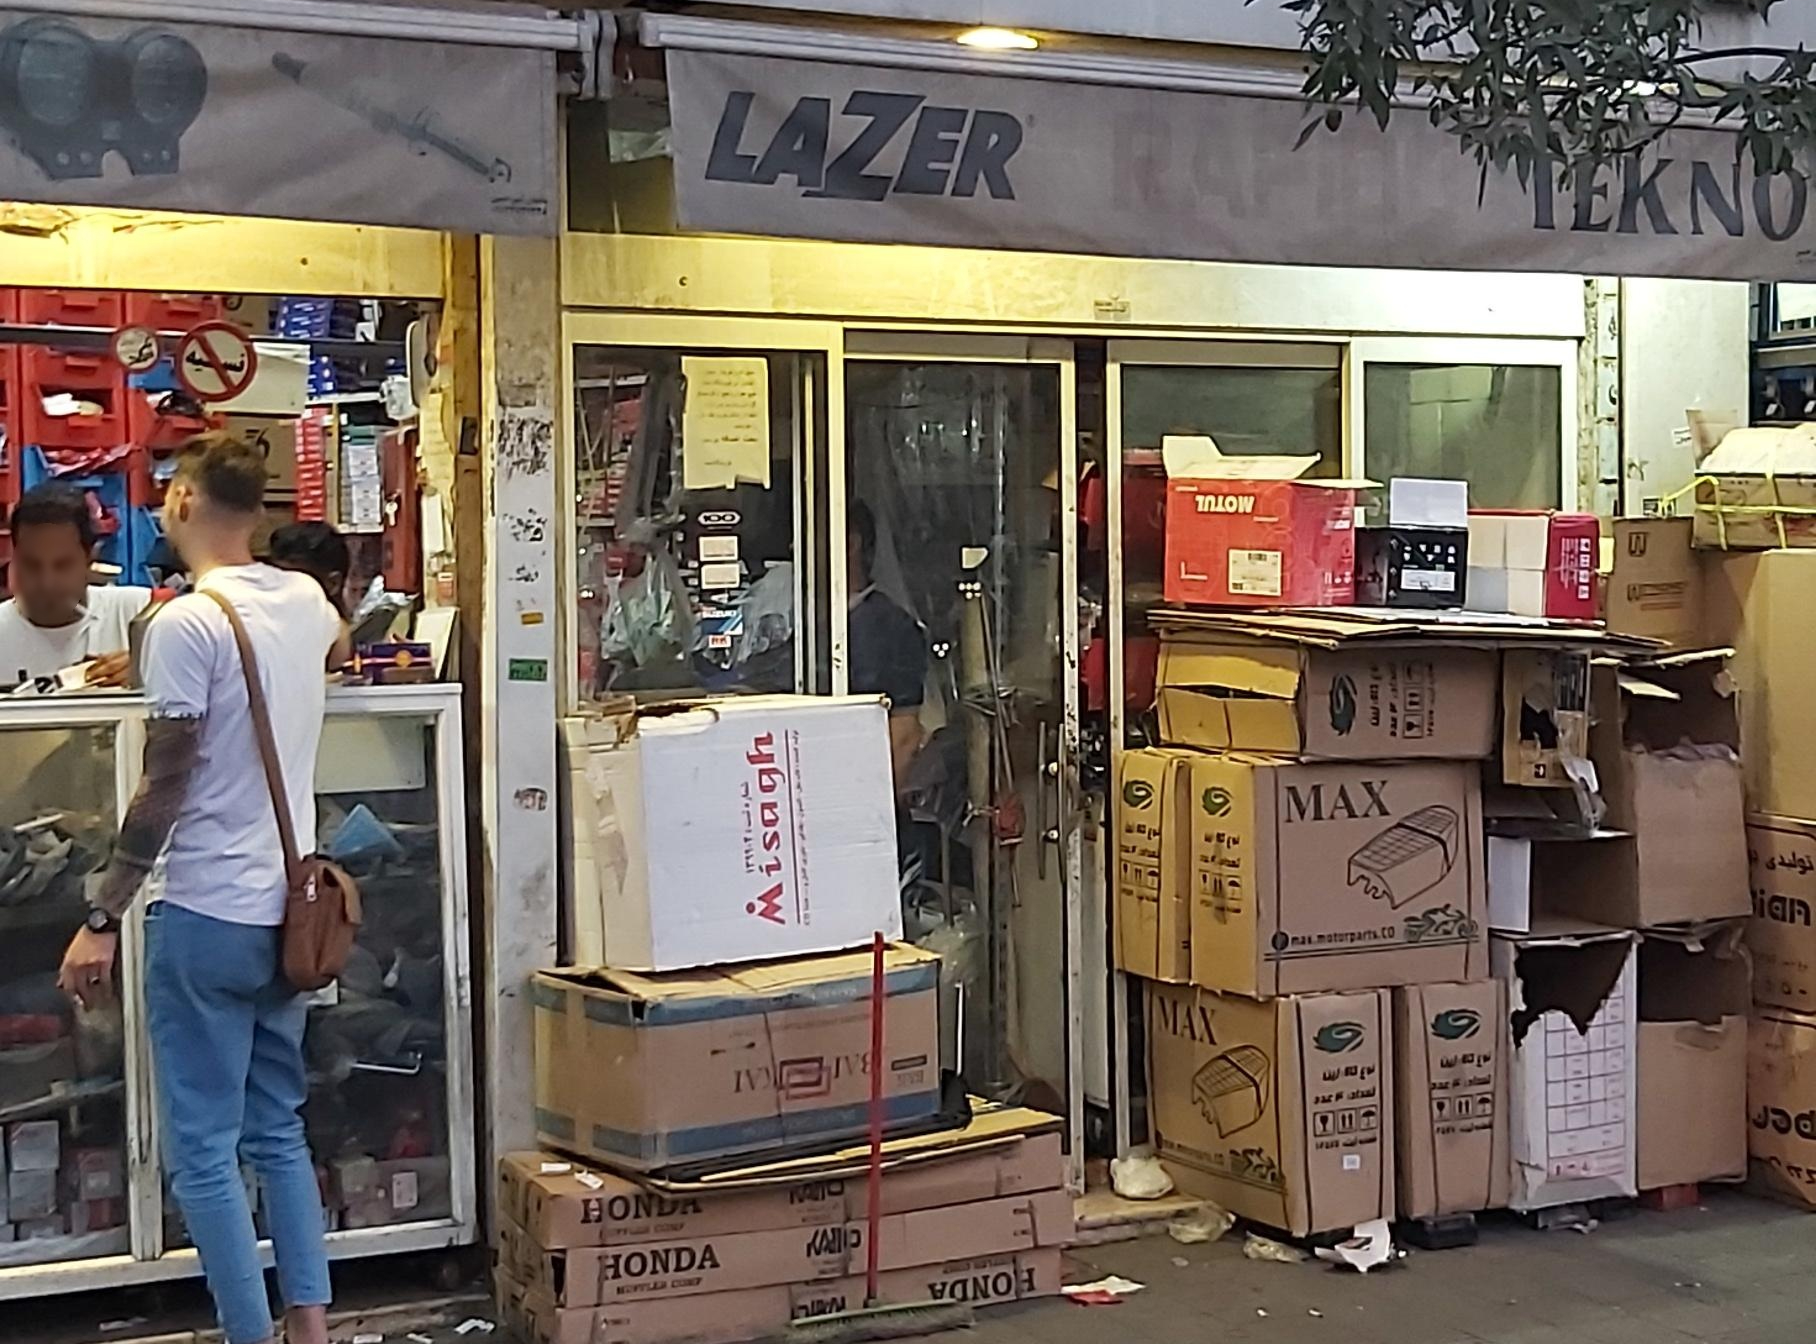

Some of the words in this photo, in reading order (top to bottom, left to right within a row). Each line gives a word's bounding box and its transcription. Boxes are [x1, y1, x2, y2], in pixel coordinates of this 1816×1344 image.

[704, 90, 1023, 202] LAZER
[1527, 151, 1808, 242] TEKNO
[1195, 494, 1255, 513] MOTUL
[1284, 779, 1392, 823] MAX
[746, 730, 787, 925] Misagh
[1158, 995, 1218, 1046] MAX
[580, 1193, 703, 1224] HONDA
[597, 1243, 721, 1281] HONDA
[927, 1266, 1036, 1302] HONDA
